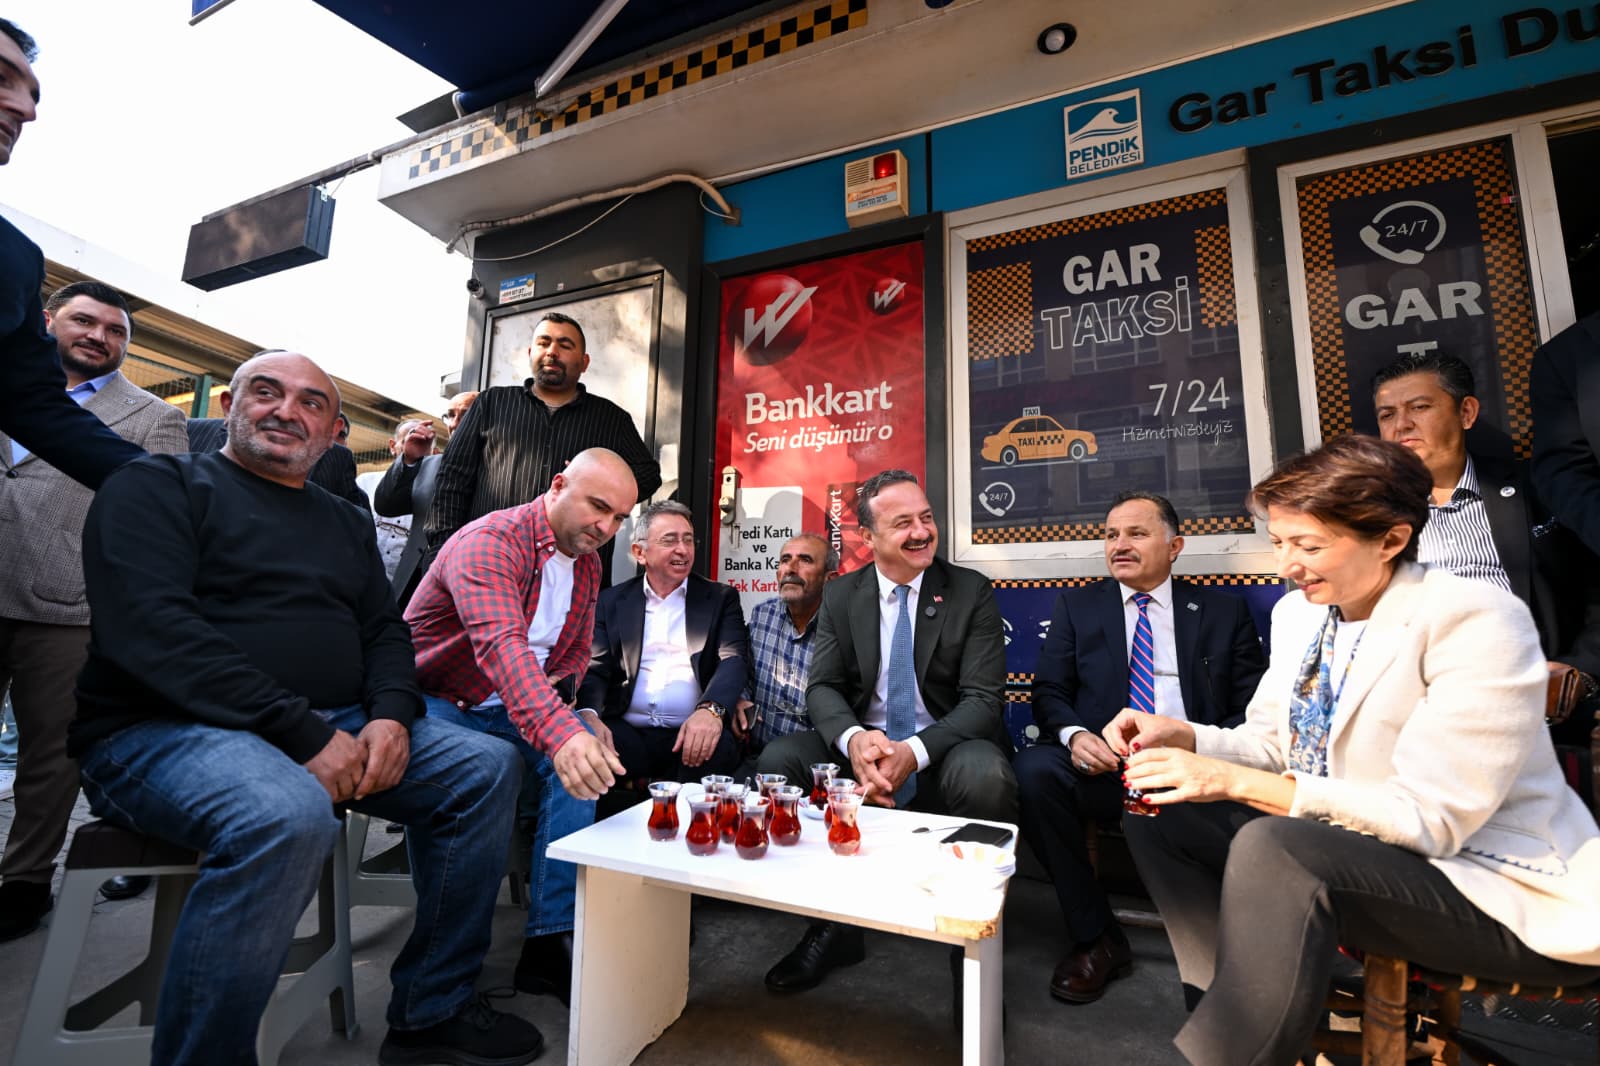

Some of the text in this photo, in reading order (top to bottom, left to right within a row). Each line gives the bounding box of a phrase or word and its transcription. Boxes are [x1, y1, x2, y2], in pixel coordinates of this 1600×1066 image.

[1168, 82, 1276, 133] Gar
[1293, 24, 1477, 104] Taksi
[1385, 219, 1428, 238] 24/7
[1062, 243, 1162, 295] GAR
[1345, 281, 1485, 330] GAR
[745, 381, 893, 425] Bankkart
[1148, 376, 1231, 417] 7/24
[1024, 408, 1039, 416] TAXI
[744, 421, 894, 453] Seni düşünür o
[1017, 437, 1035, 447] TAXI
[989, 492, 1009, 502] 24/7
[763, 525, 793, 539] Kartı
[752, 543, 767, 553] ve
[724, 556, 780, 571] Banka Ka
